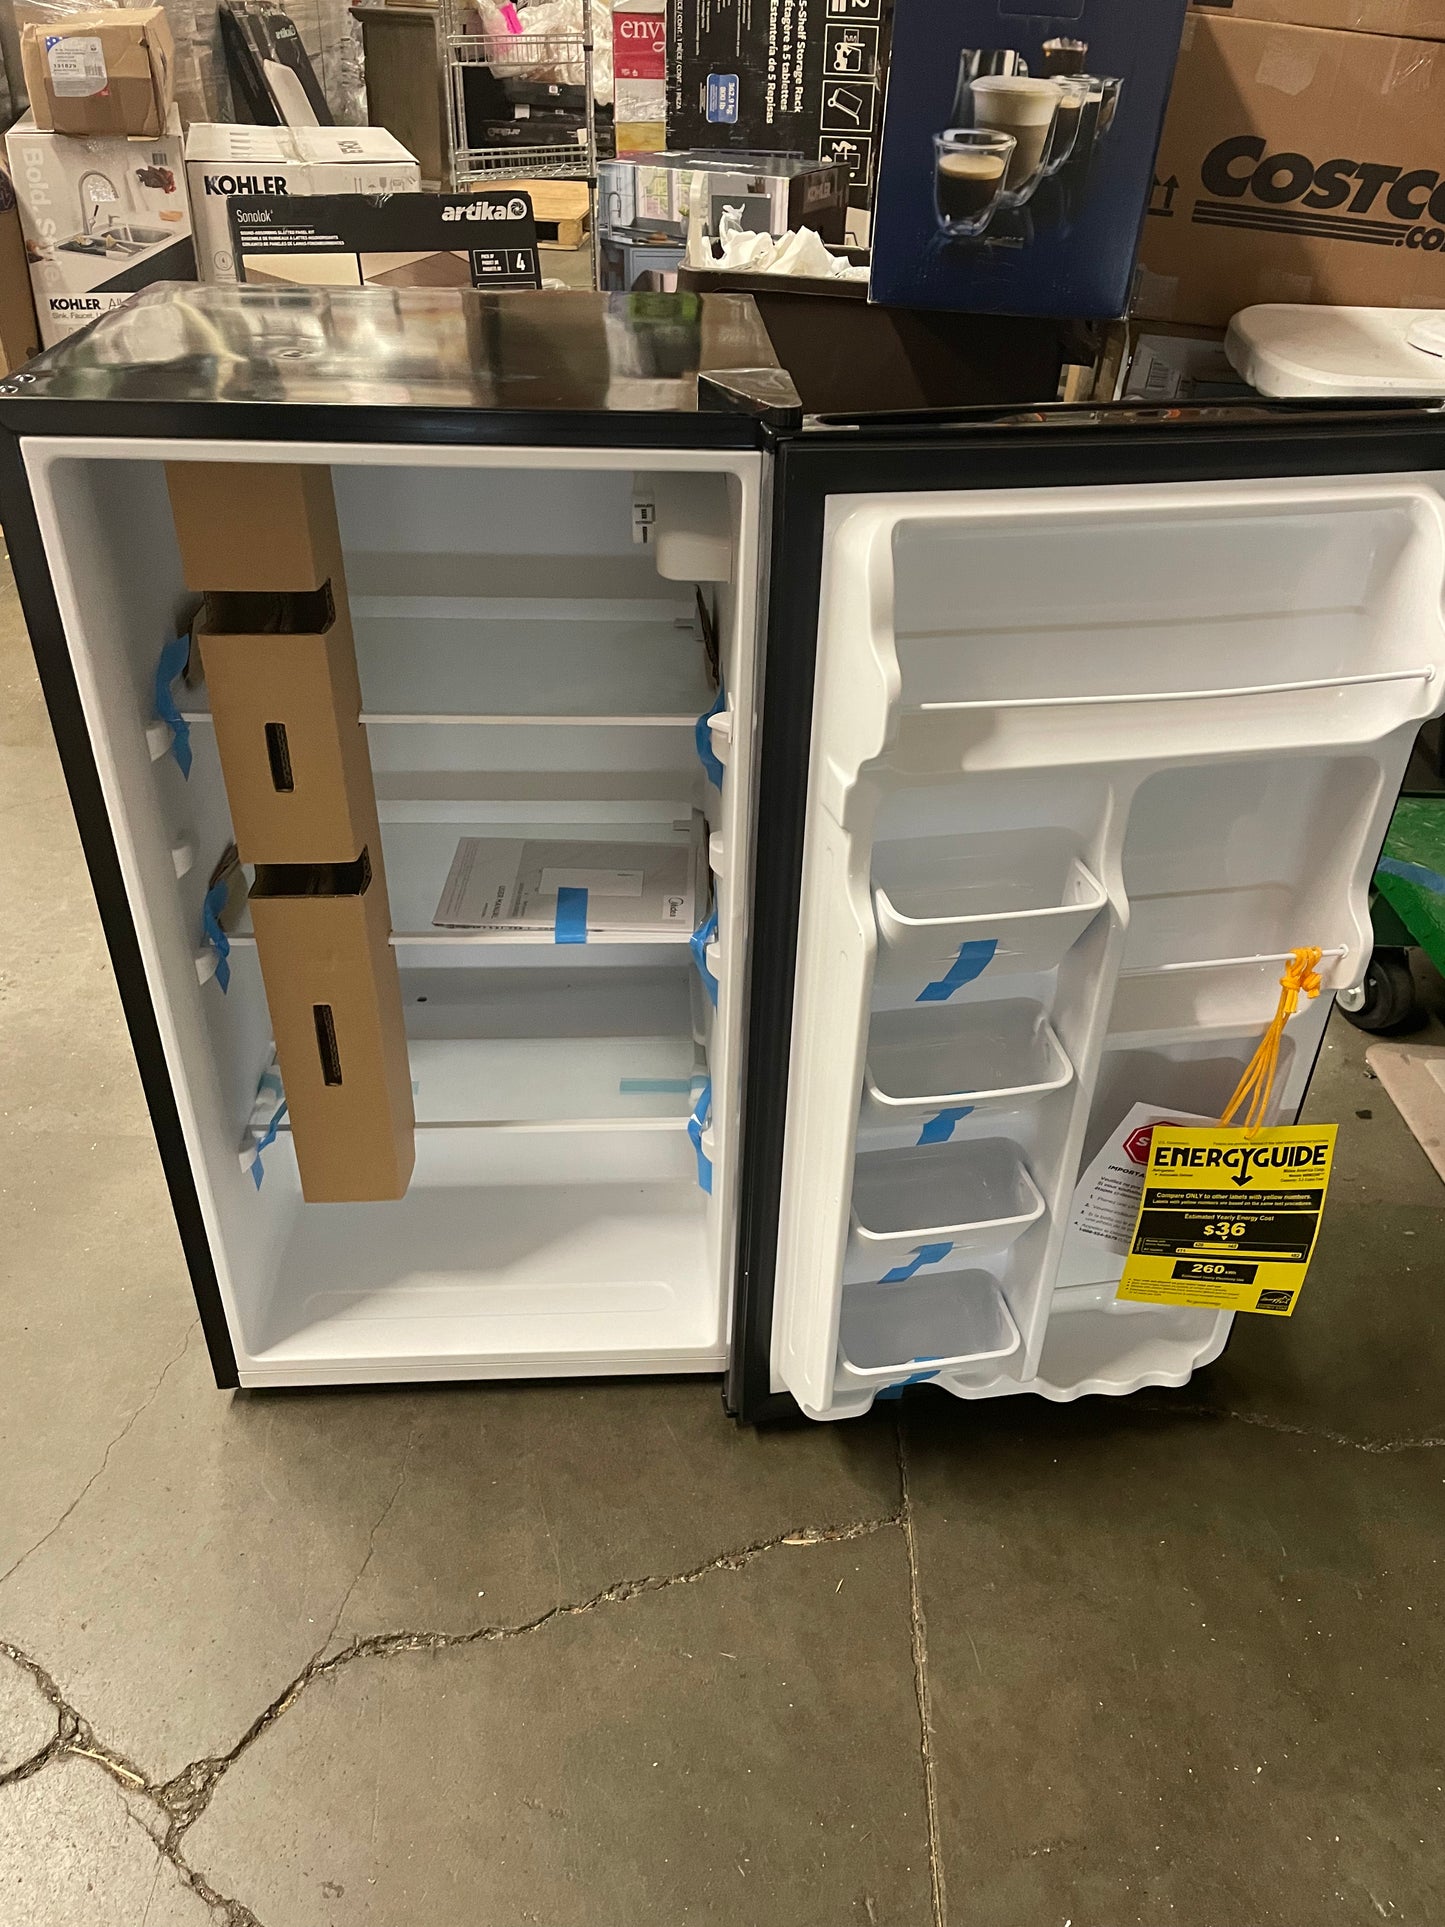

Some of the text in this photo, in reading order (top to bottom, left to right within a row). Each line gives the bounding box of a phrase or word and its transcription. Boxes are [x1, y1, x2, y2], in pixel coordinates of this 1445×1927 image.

[768, 0, 780, 56] Estantería
[768, 58, 778, 72] de
[793, 41, 806, 84] Storage
[780, 62, 791, 111] tablettes
[764, 82, 776, 124] Repisas
[794, 86, 804, 113] Rack
[204, 175, 289, 195] KOHLER
[1201, 135, 1445, 224] COSTC
[441, 201, 507, 221] artika
[516, 253, 526, 271] 4
[49, 298, 102, 310] KOHLER
[1154, 1145, 1328, 1169] ENERGYGUIDE
[1108, 1165, 1145, 1178] IMPORTA
[1203, 1222, 1246, 1237] $36
[1191, 1264, 1225, 1274] 260
